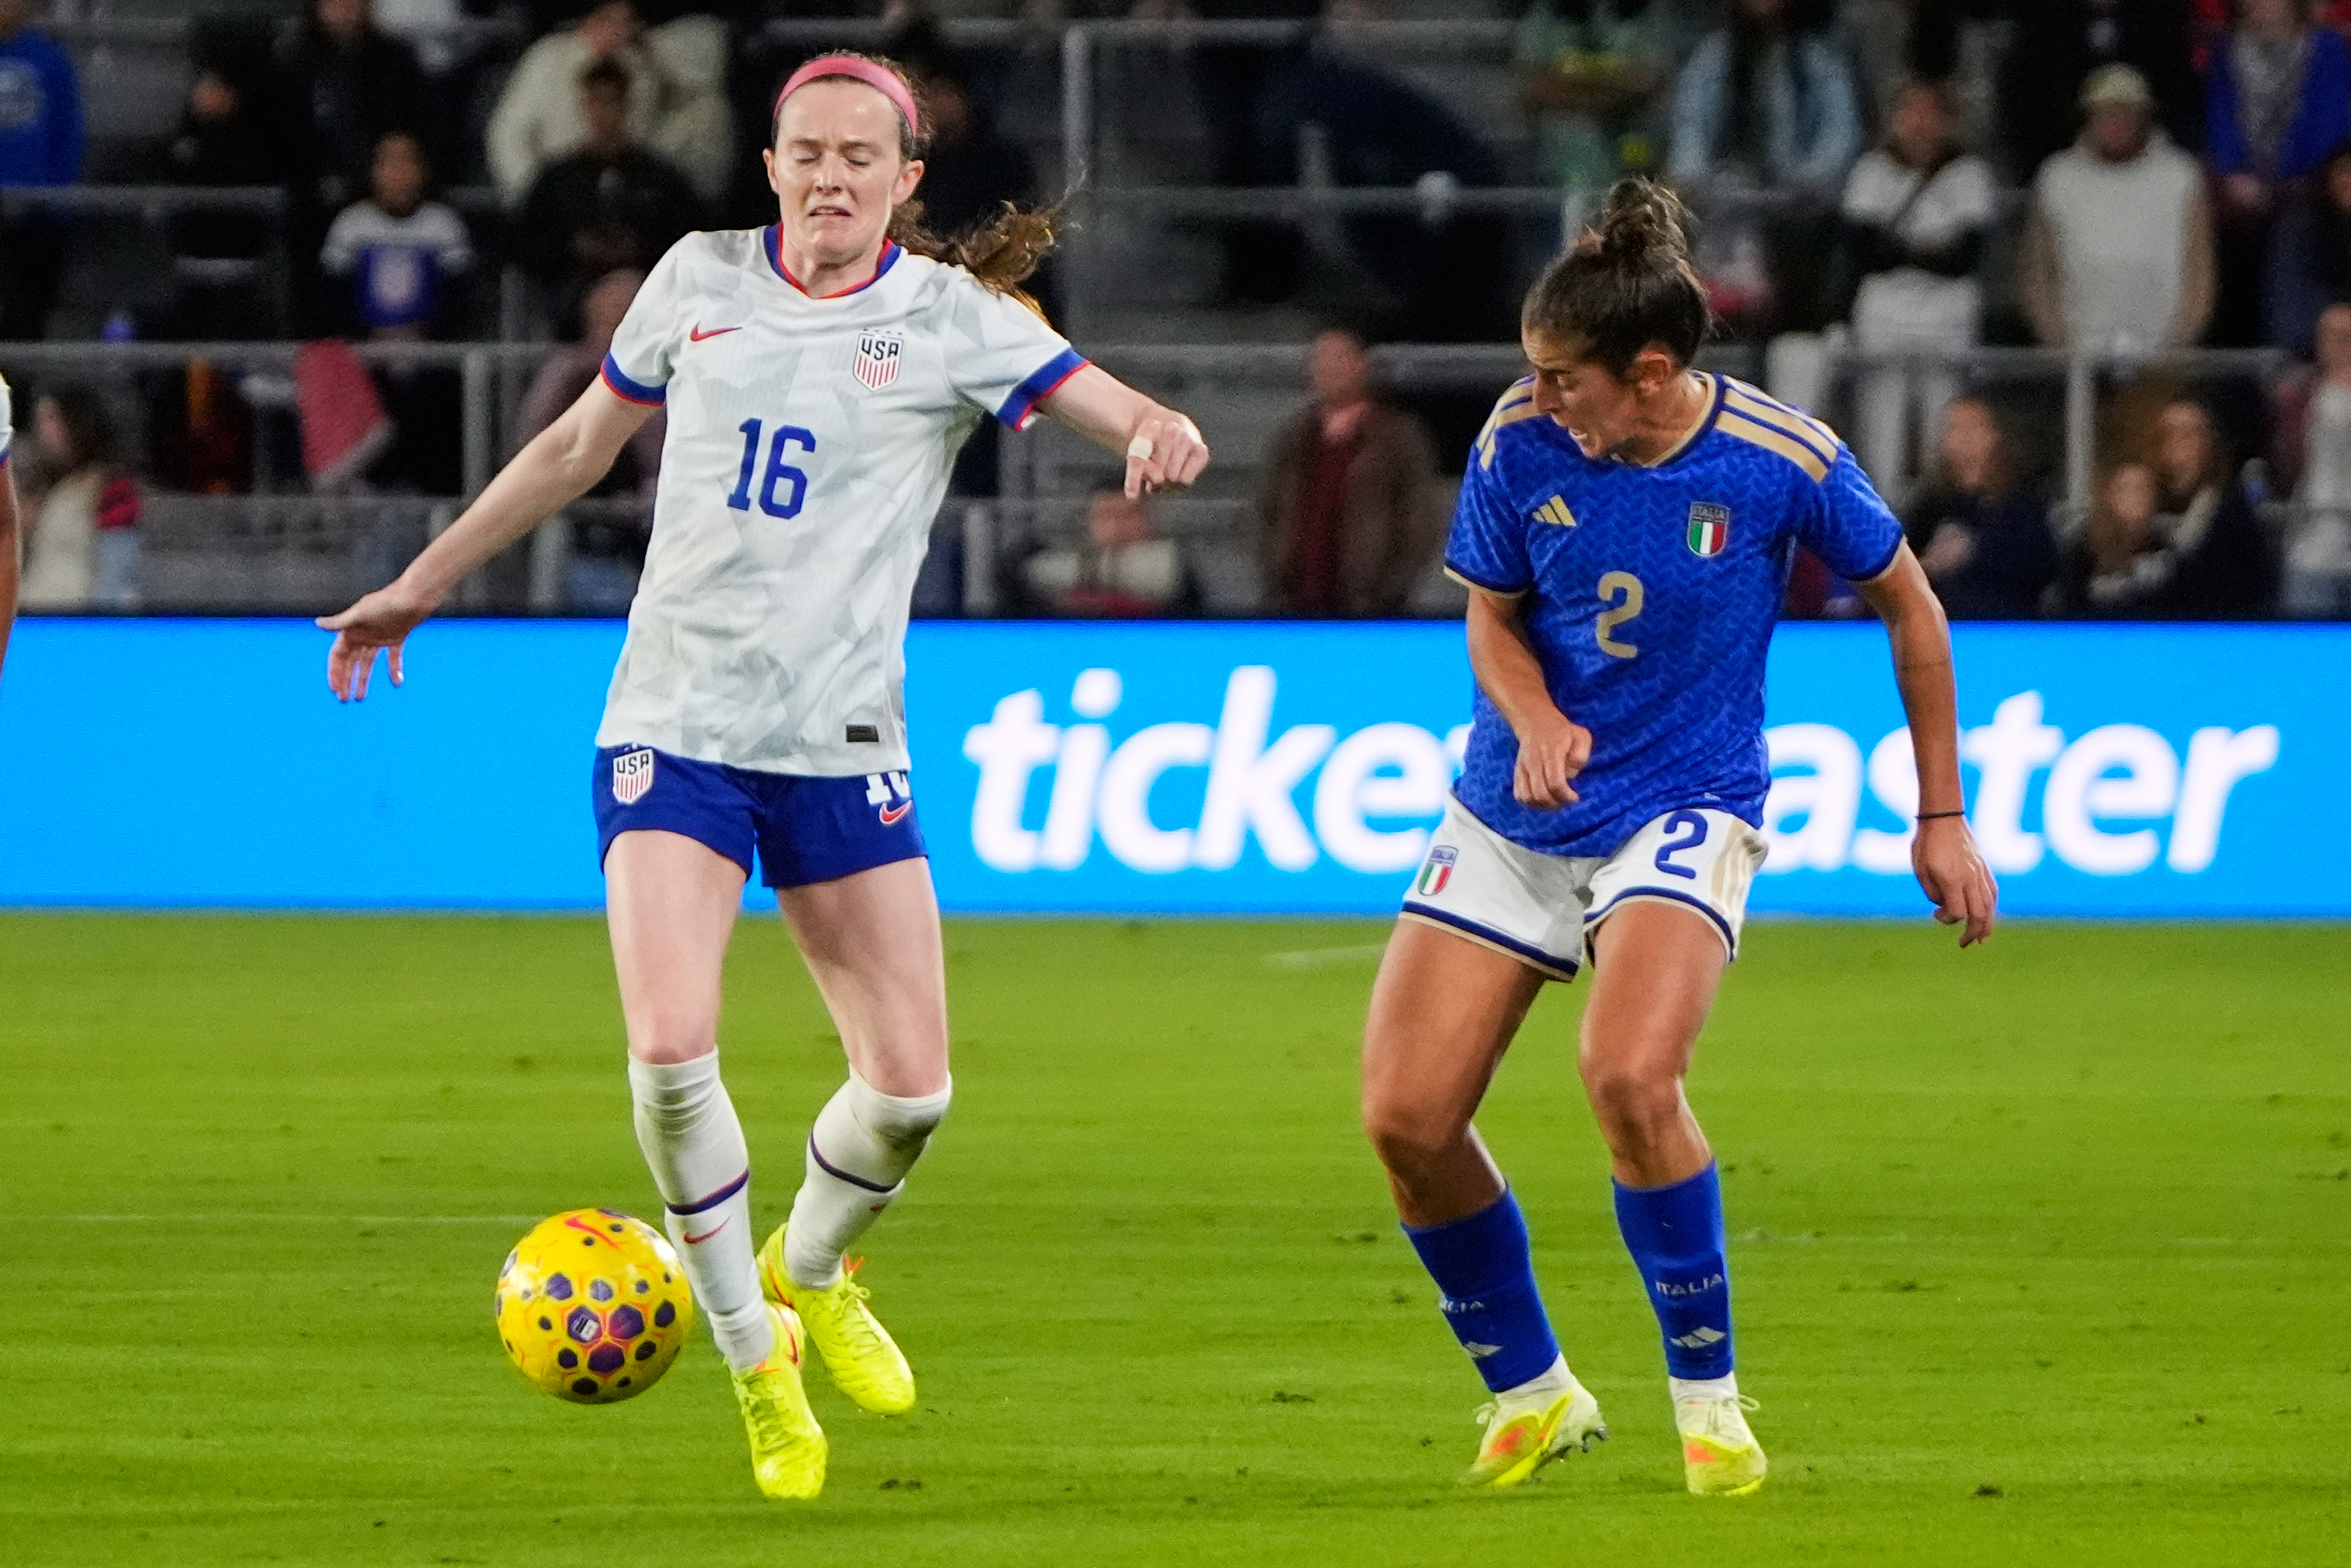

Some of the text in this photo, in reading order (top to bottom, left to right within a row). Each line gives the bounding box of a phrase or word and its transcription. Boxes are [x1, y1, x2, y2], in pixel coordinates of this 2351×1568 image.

[861, 338, 899, 361] USA
[727, 418, 817, 520] 16
[1595, 570, 1645, 660] 2
[617, 754, 649, 775] USA
[963, 664, 2279, 875] tickeaster
[1654, 809, 1709, 879] 2
[1655, 1273, 1723, 1295] ITALIA
